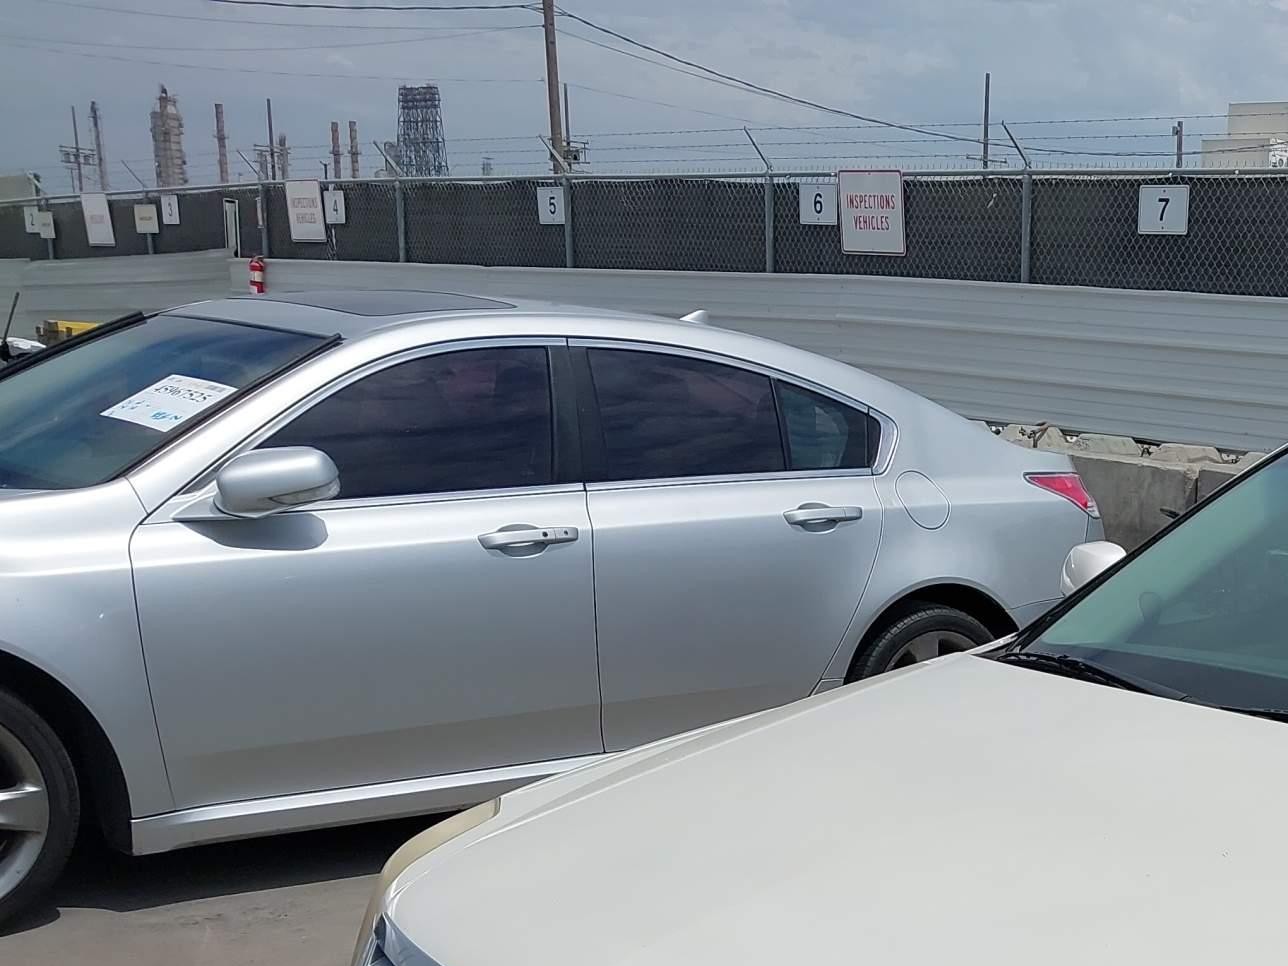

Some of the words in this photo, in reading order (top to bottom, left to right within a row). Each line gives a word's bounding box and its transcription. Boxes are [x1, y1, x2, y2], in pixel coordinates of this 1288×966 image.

[168, 202, 173, 217] 3
[332, 199, 339, 216] 4
[549, 196, 556, 215] 5
[813, 192, 823, 215] 6
[846, 193, 896, 210] INSPECTIONS
[1158, 197, 1170, 222] 7
[853, 215, 890, 231] VEHICLES
